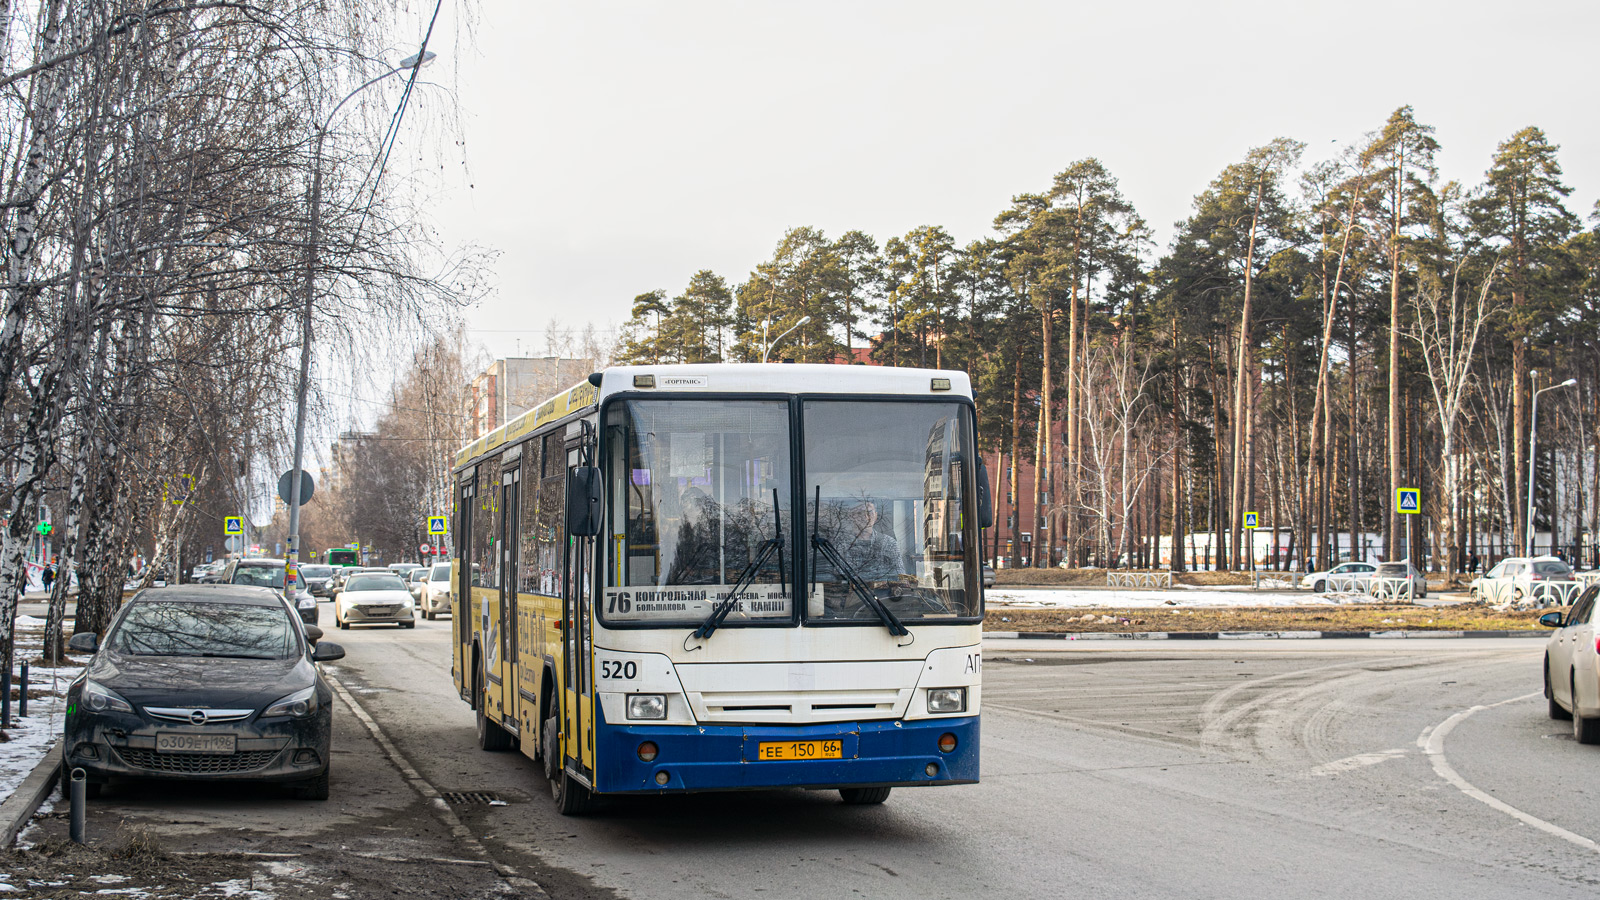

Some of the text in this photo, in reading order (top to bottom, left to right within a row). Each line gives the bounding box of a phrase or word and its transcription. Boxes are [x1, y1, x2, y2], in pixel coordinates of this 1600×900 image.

[606, 591, 631, 614] 76
[635, 590, 707, 602] КОНТРОЛЬНАЯ
[636, 603, 687, 612] БОЛЬШАКОВА
[750, 600, 785, 612] КАМНИ
[602, 660, 637, 679] 520
[213, 737, 231, 746] 196
[766, 741, 837, 758] ЕЕ 150 66
